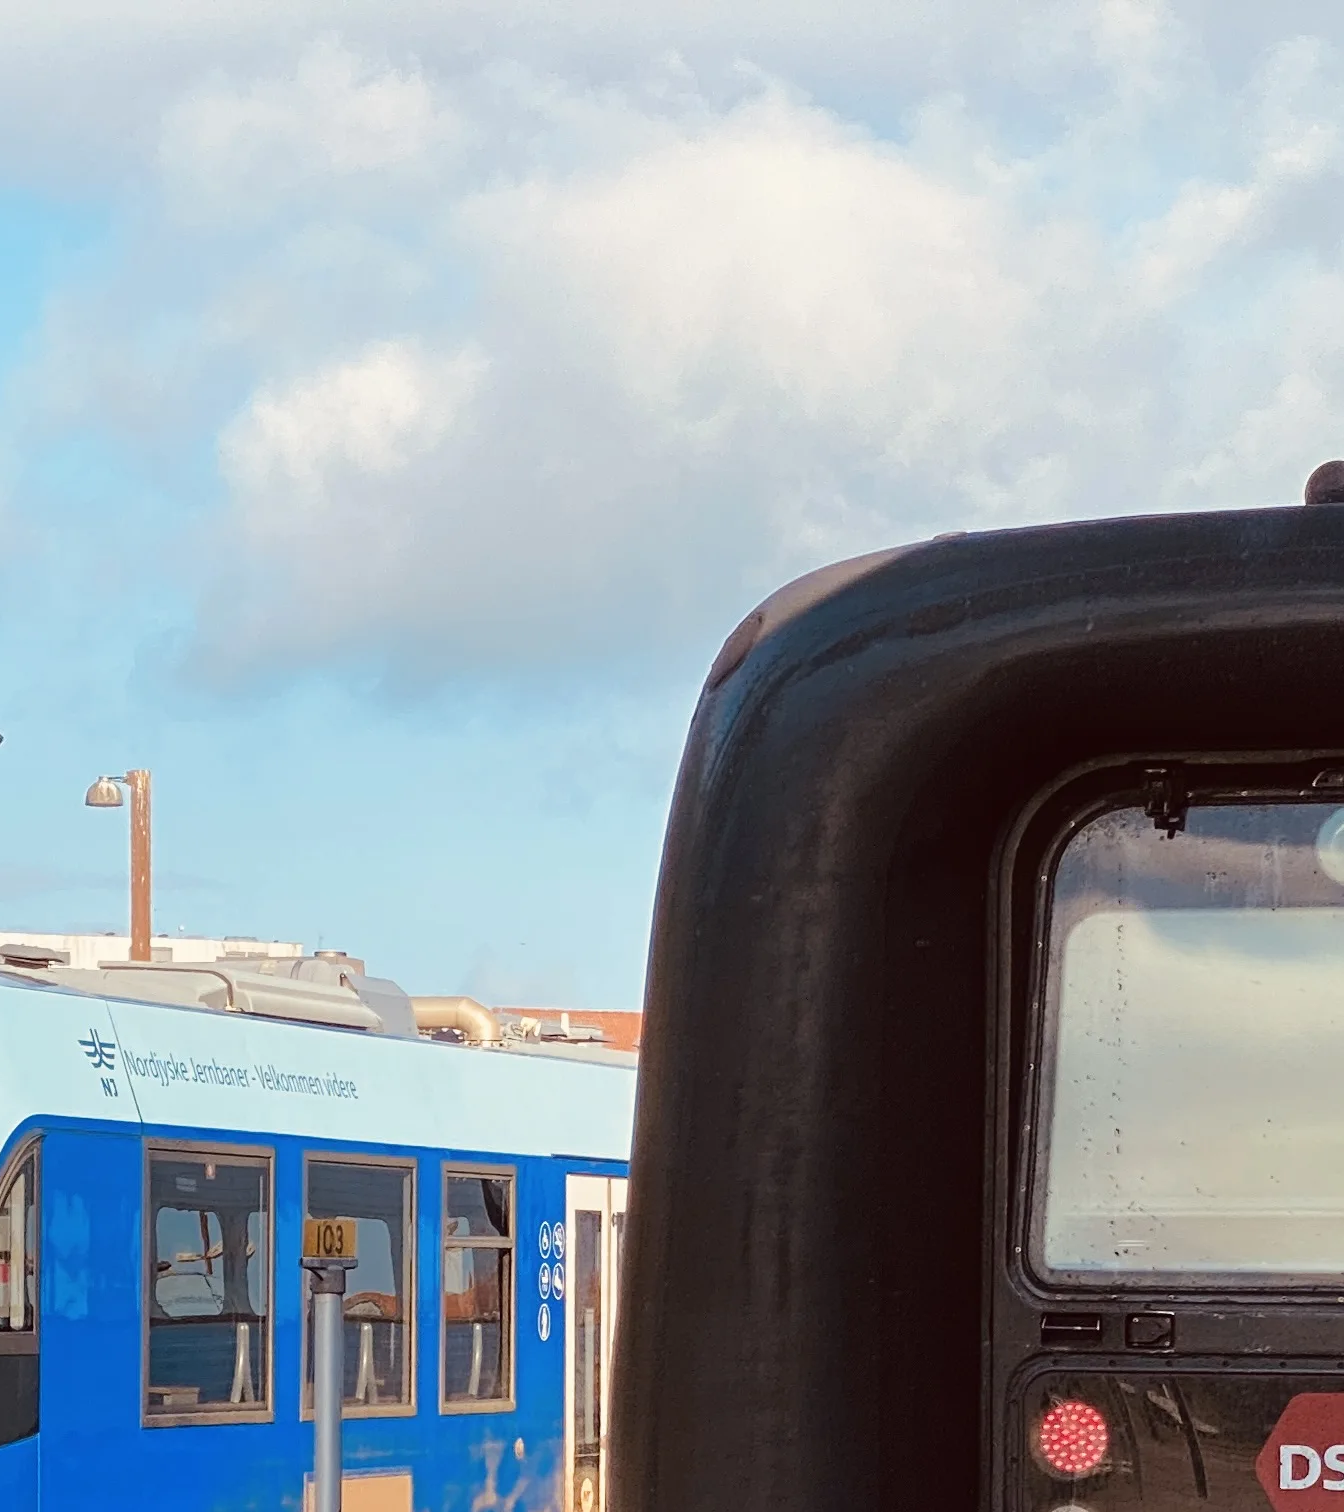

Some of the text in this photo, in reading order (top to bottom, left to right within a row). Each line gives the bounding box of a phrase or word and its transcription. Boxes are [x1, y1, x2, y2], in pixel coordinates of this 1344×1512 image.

[100, 1077, 119, 1097] NJ
[123, 1050, 190, 1087] Nordjyske
[189, 1057, 250, 1088] Jernbaner
[253, 1064, 325, 1096] Velkommen
[322, 1072, 359, 1100] videre
[316, 1225, 344, 1254] 103
